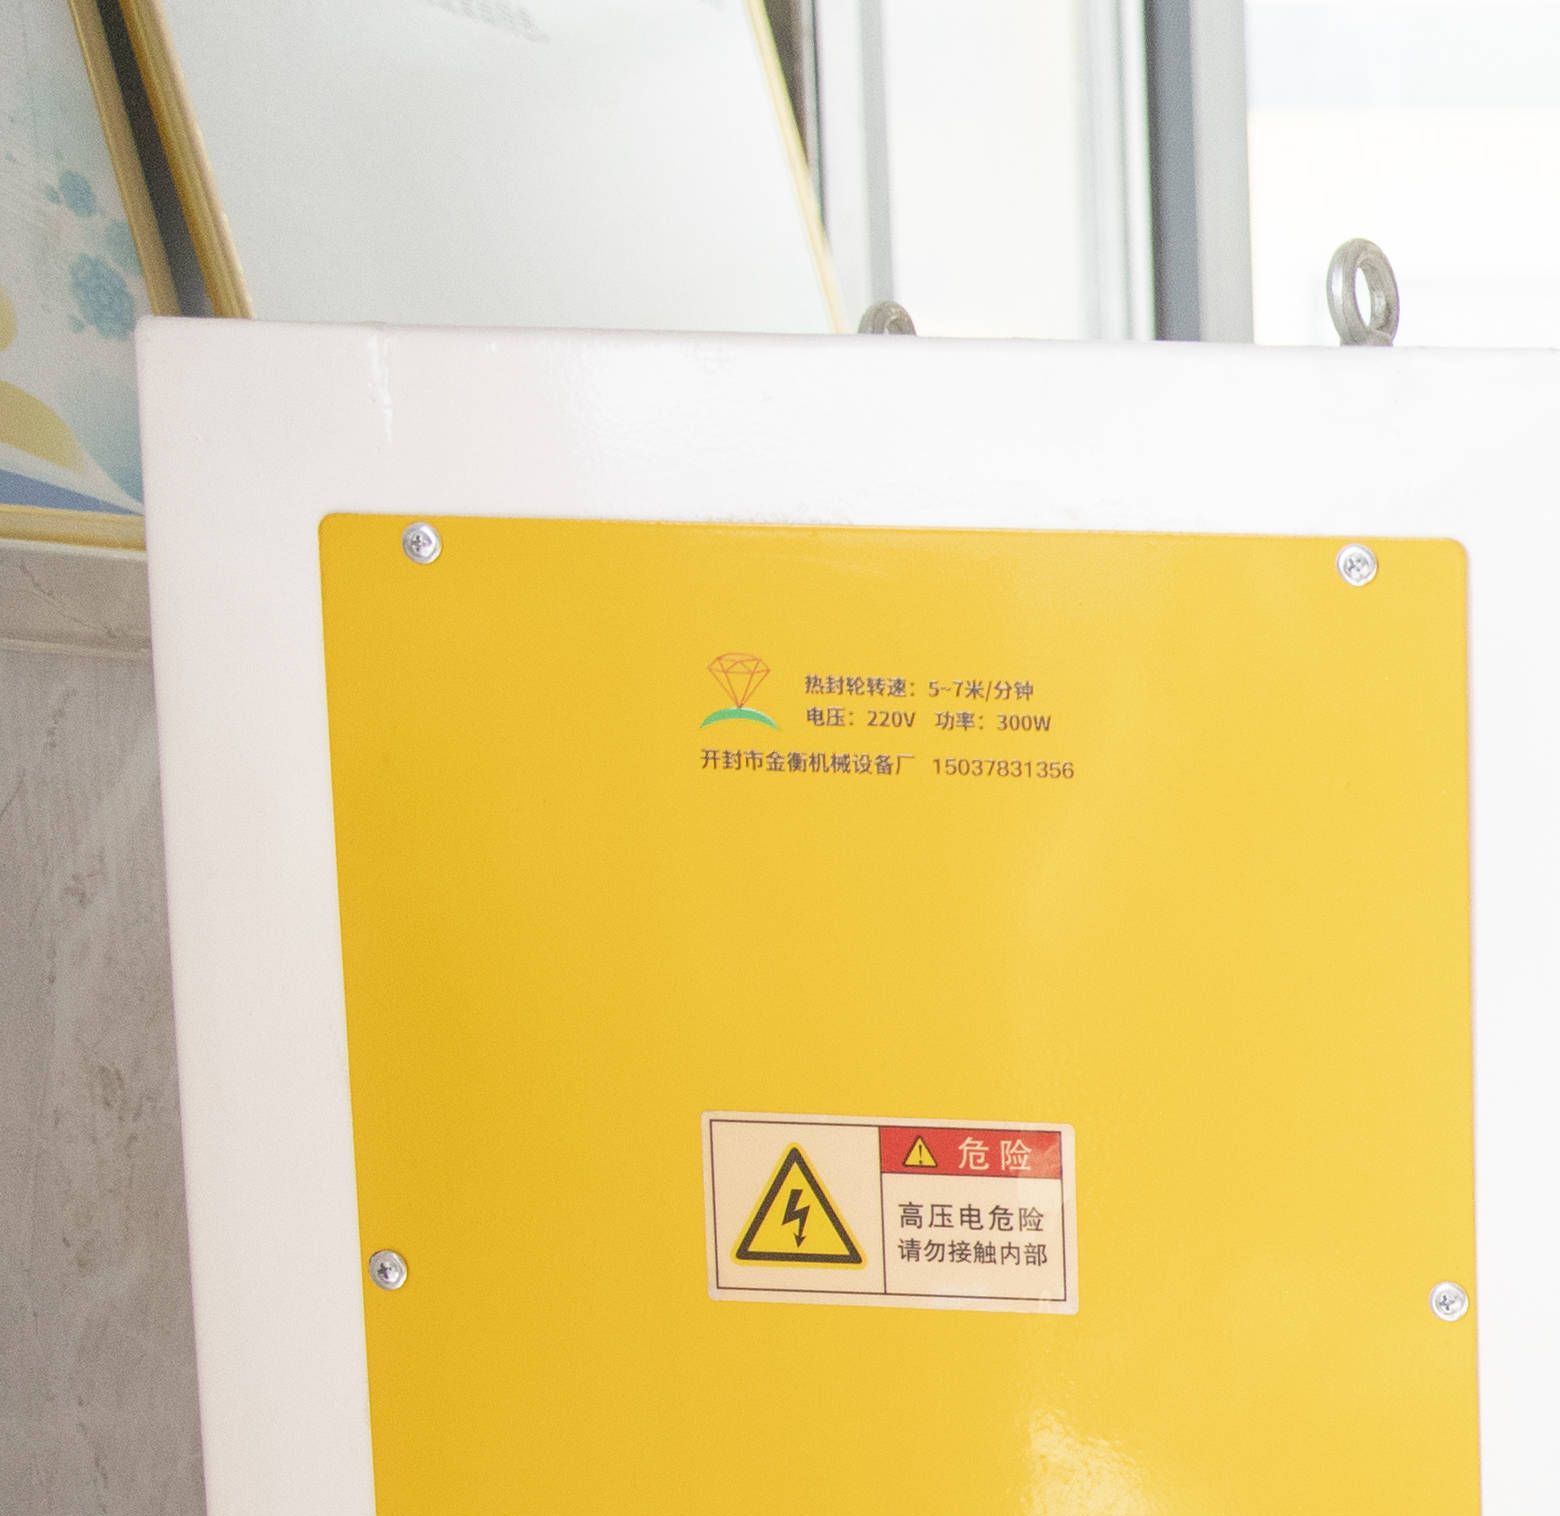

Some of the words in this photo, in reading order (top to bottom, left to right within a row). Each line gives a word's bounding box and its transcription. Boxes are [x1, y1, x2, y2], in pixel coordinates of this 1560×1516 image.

[700, 748, 915, 775] 开封市金衡机械设备厂
[933, 757, 1075, 779] 15037831356
[957, 1135, 1033, 1172] 危险
[897, 1201, 1045, 1232] 高压电危险
[897, 1238, 1048, 1267] 请勿接触内部
